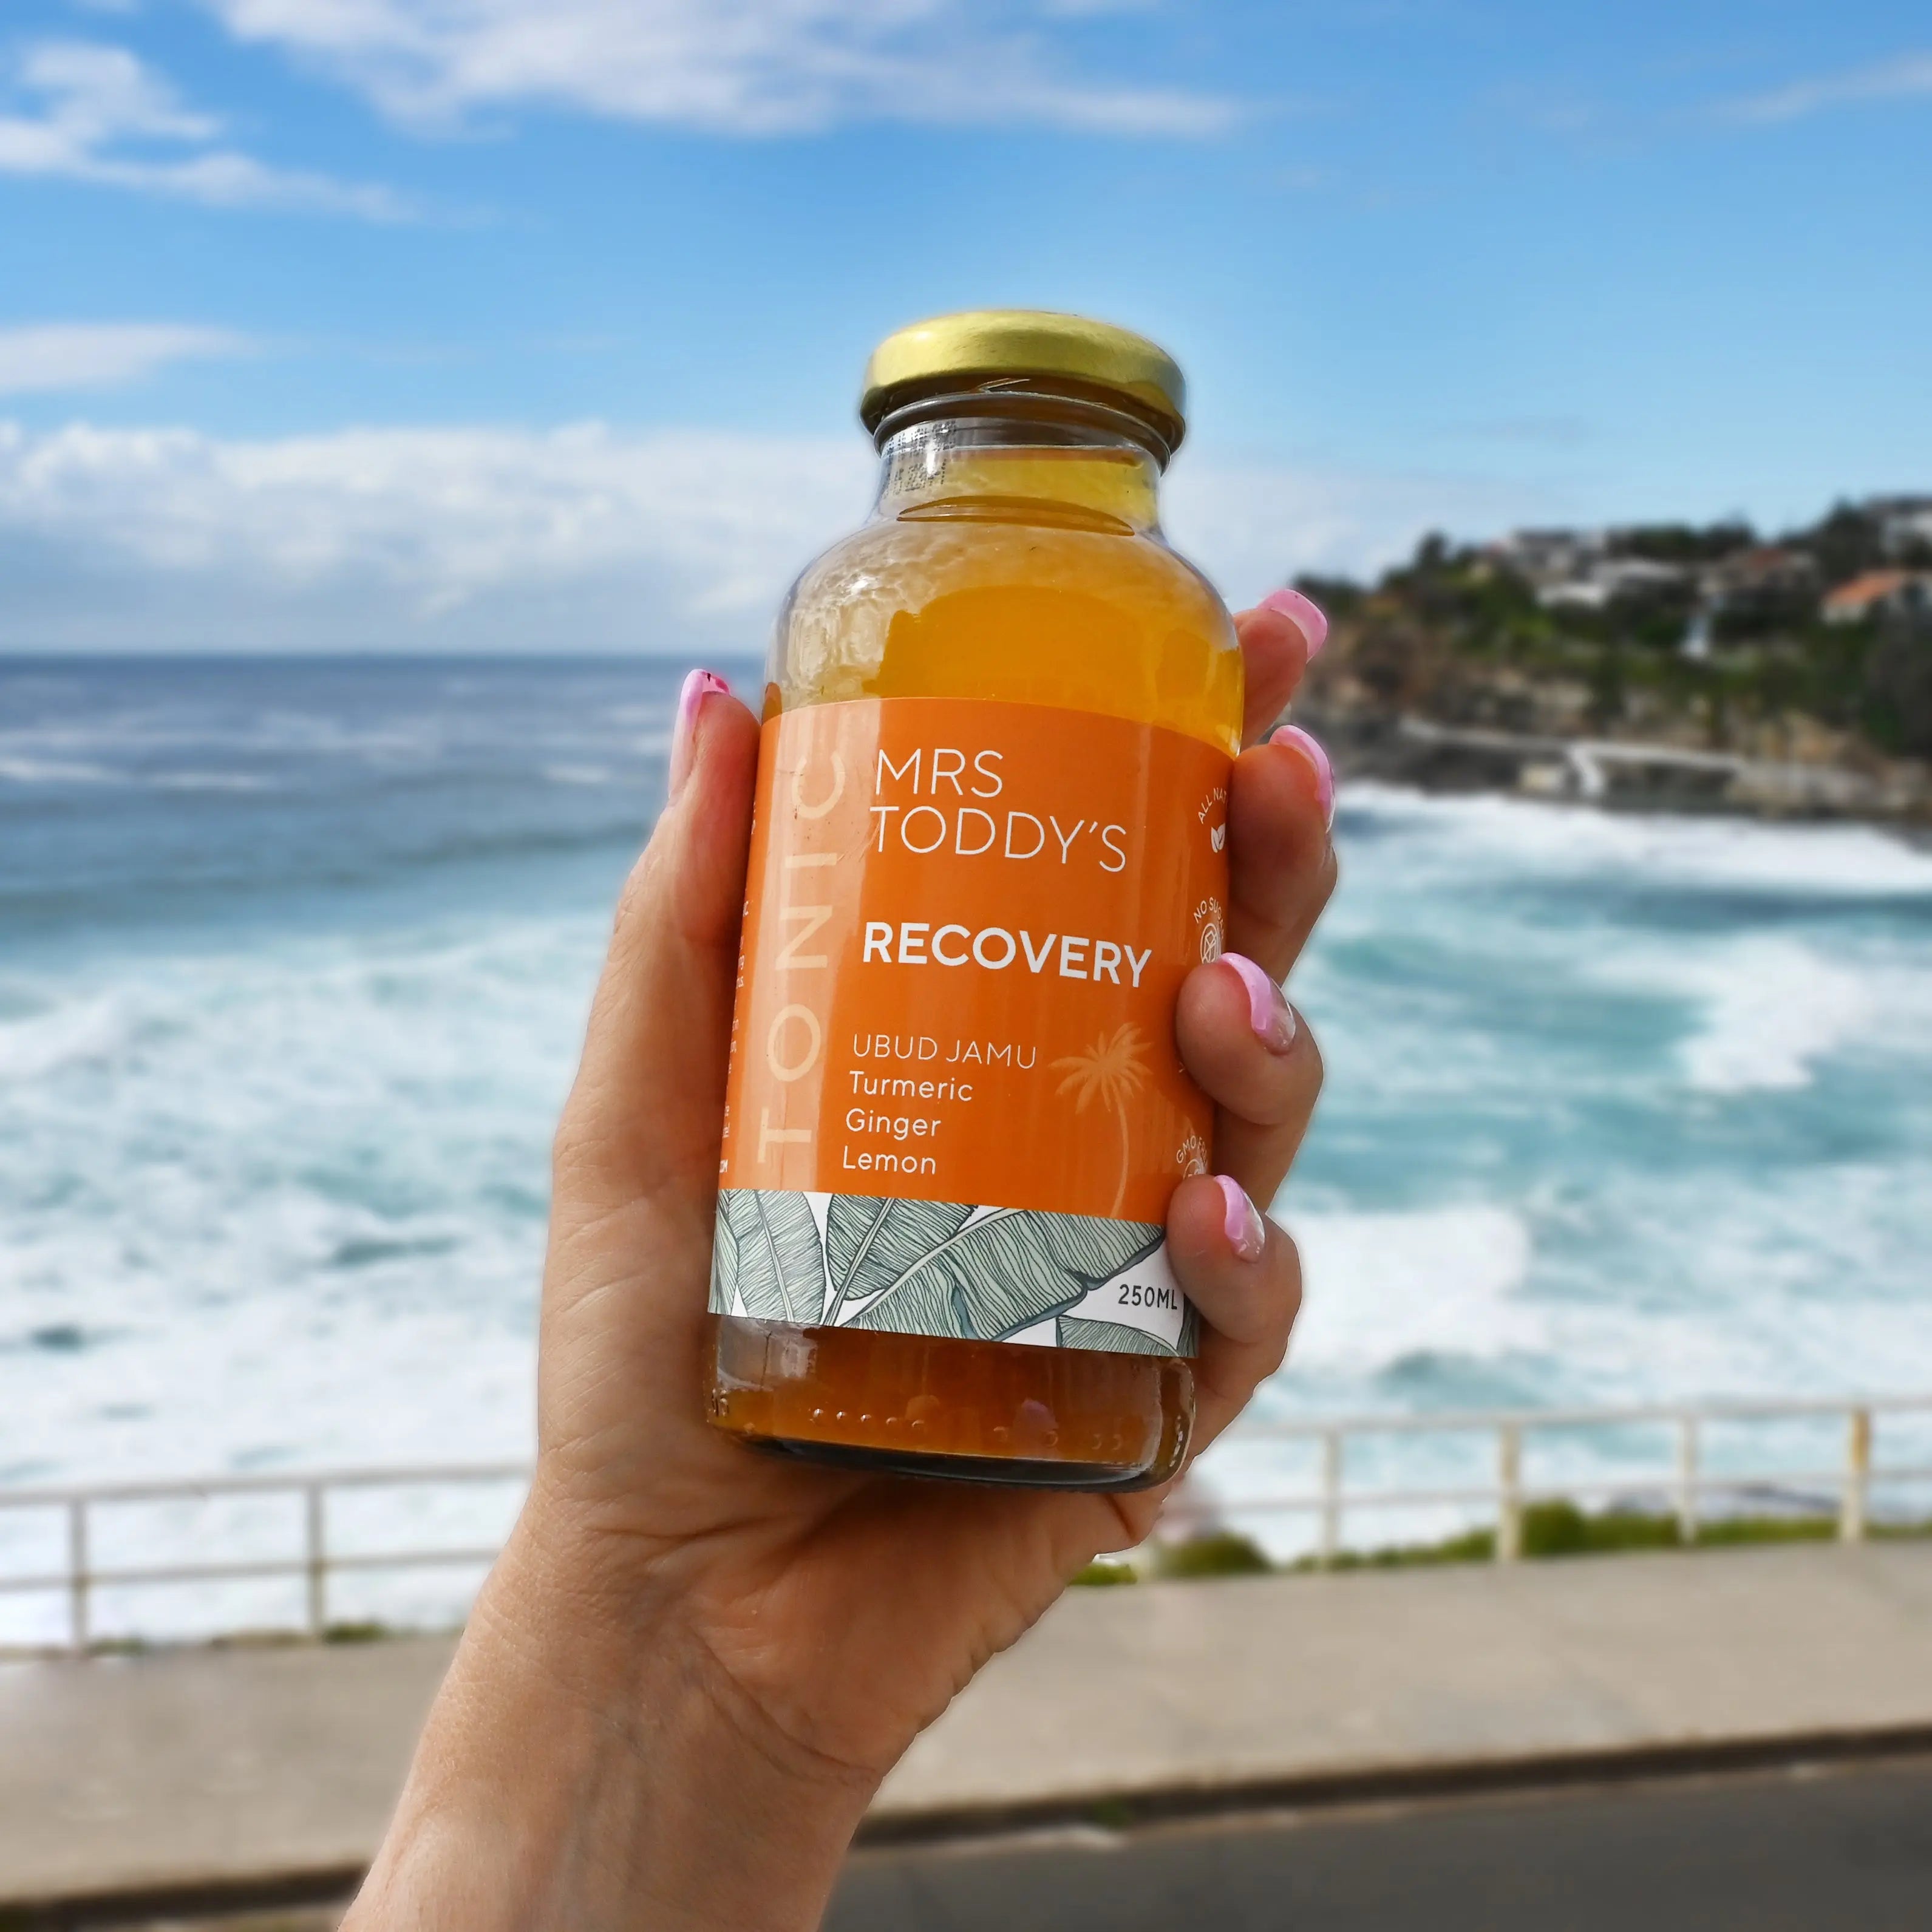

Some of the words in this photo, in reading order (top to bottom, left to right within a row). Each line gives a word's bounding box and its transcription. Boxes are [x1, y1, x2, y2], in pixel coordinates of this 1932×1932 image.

[876, 749, 1003, 798] MRS
[1198, 794, 1213, 824] ALL
[869, 806, 1126, 872] TODDY'S
[1193, 900, 1207, 923] NO
[758, 751, 845, 1163] TONIC
[863, 922, 1152, 987] RECOVERY
[852, 1033, 937, 1060] UBUD
[945, 1039, 1036, 1069] JAMU
[849, 1070, 973, 1101] Turmeric
[845, 1108, 941, 1140] Ginger
[842, 1146, 936, 1175] Lemon
[1176, 1135, 1196, 1164] GMO
[1118, 1284, 1177, 1310] 250ML
